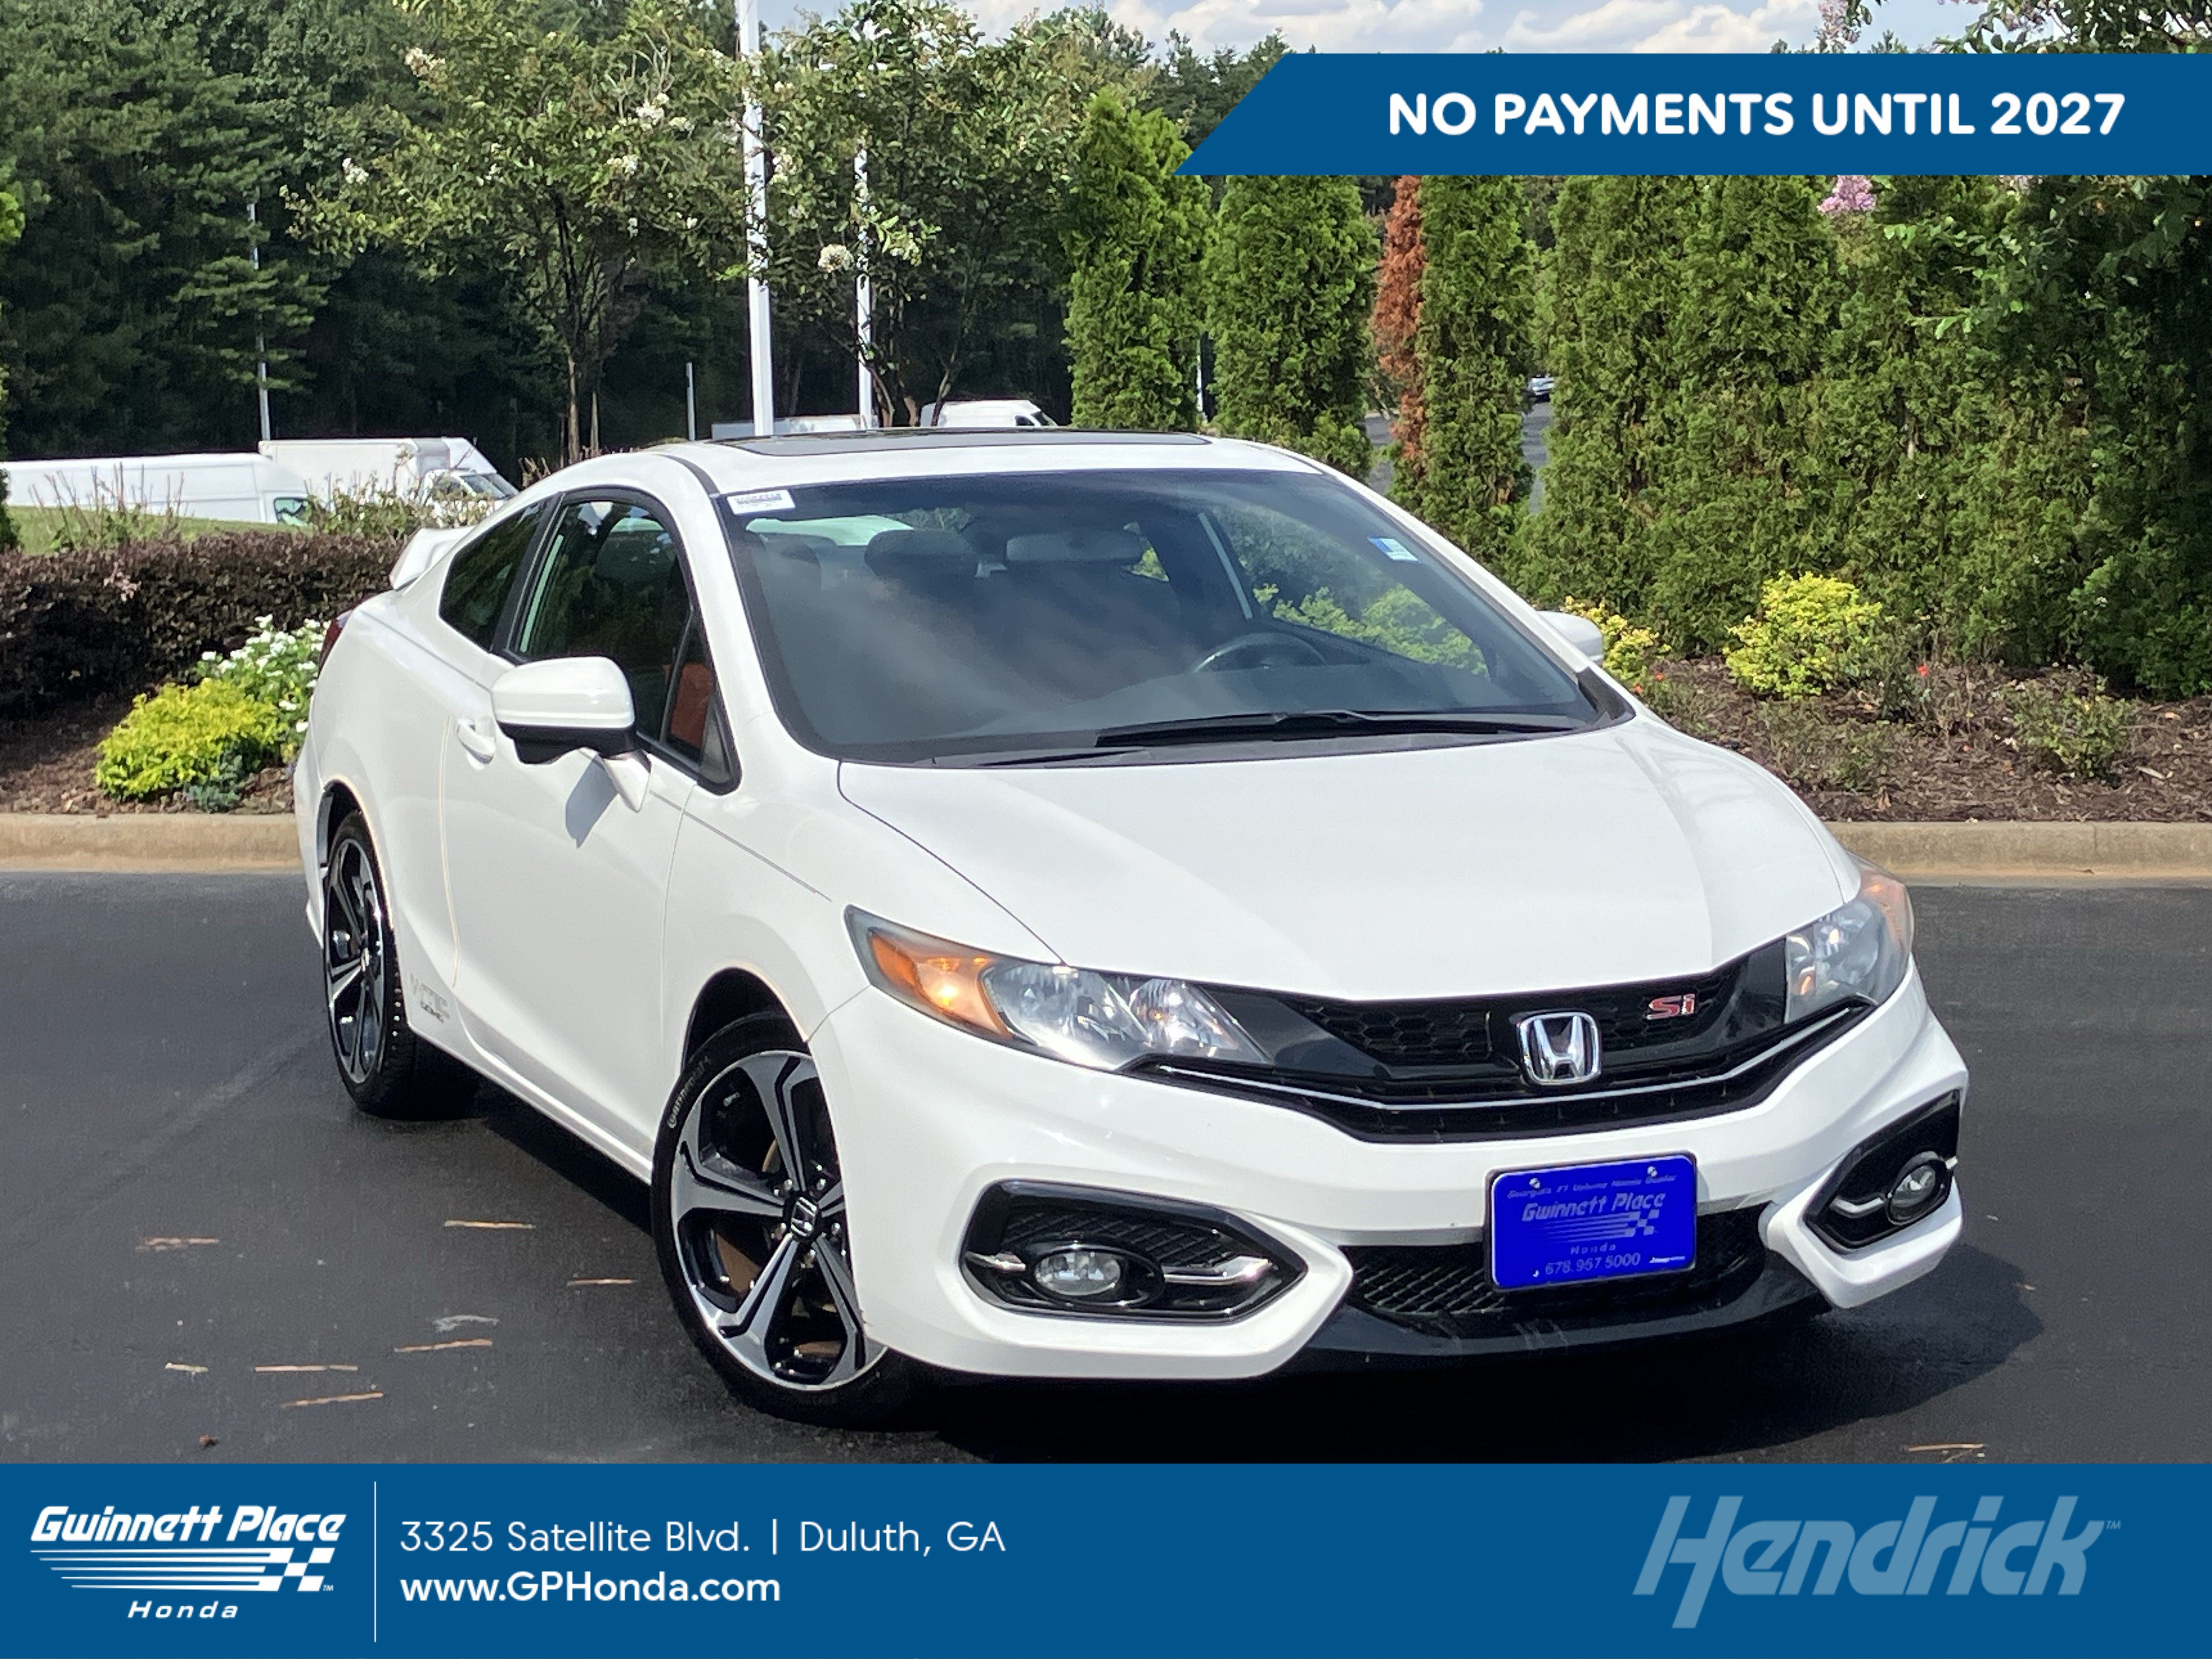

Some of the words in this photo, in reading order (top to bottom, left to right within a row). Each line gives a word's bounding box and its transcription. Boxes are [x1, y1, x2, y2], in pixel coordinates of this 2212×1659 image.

[1647, 994, 1695, 1020] Si
[1522, 1195, 1607, 1222] Gwinnett
[1611, 1192, 1666, 1212] Place
[1545, 1252, 1641, 1275] 678.9575000
